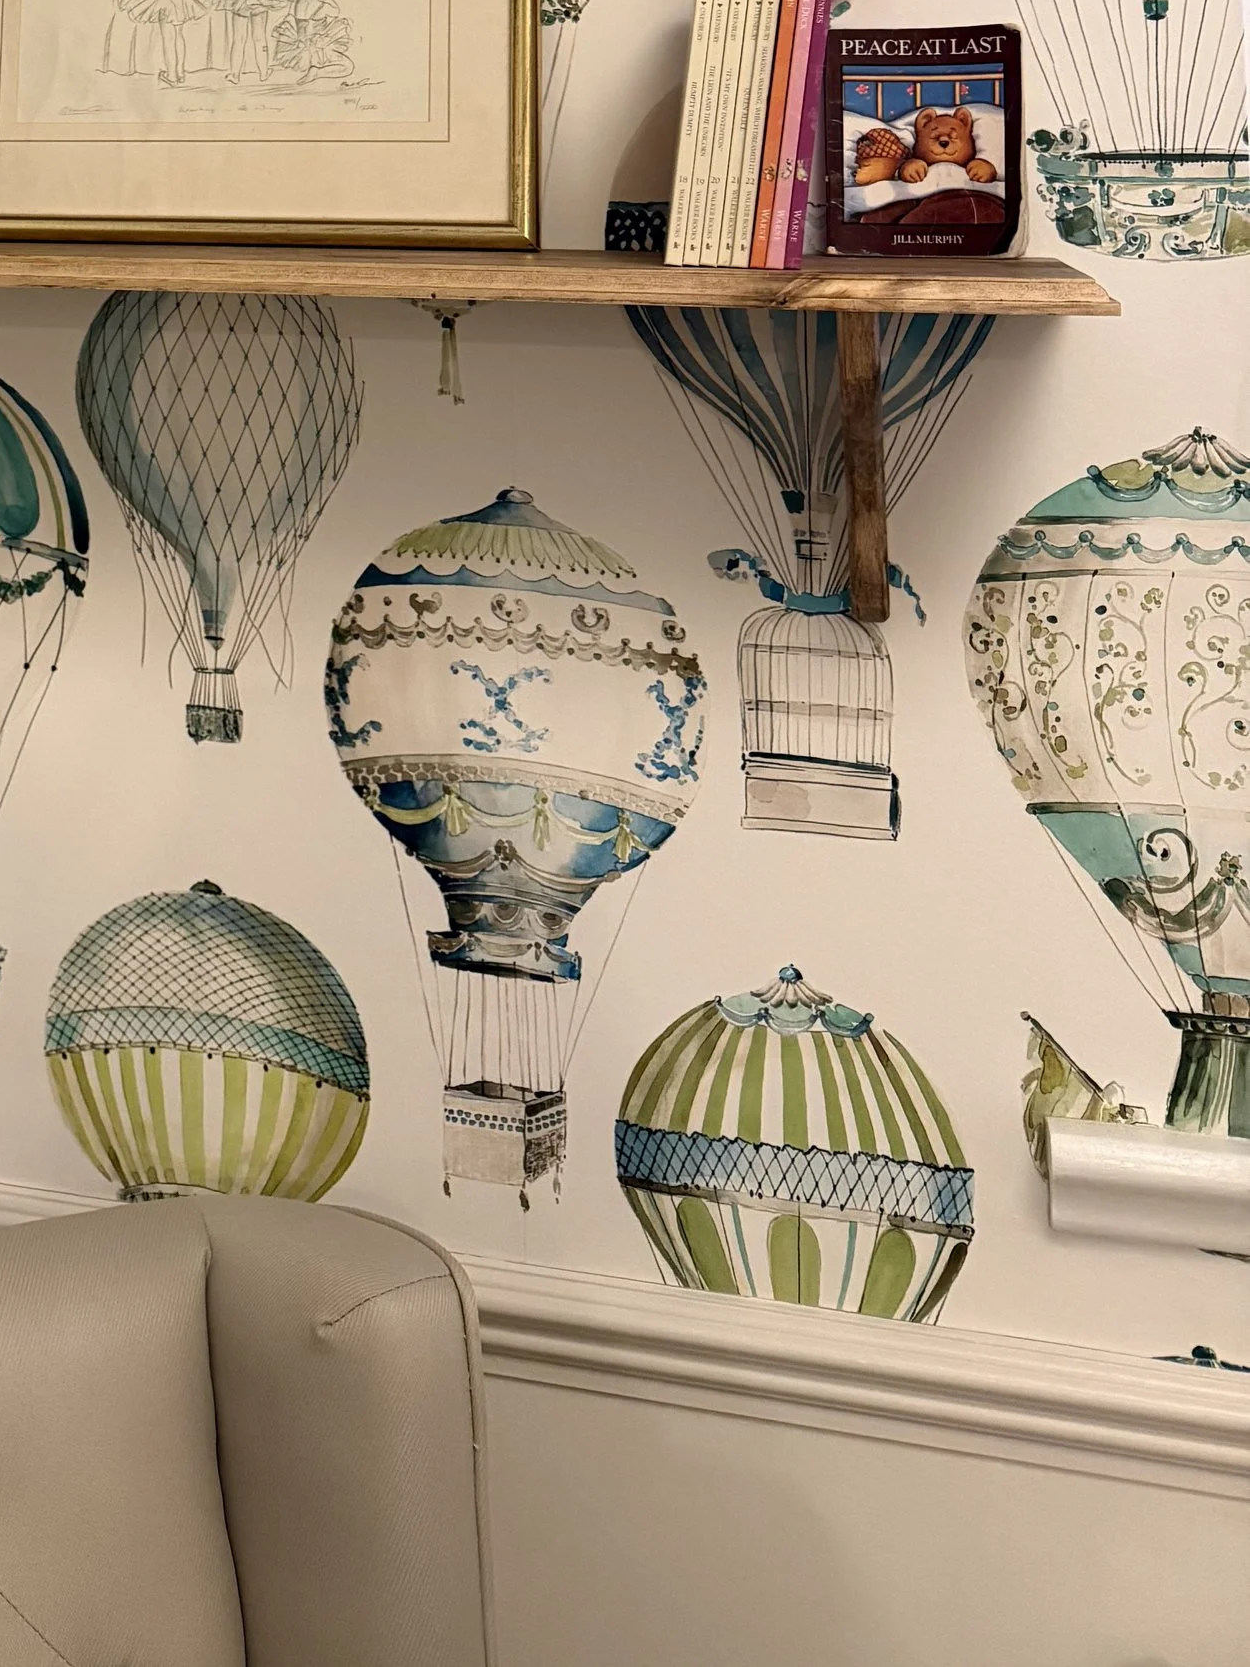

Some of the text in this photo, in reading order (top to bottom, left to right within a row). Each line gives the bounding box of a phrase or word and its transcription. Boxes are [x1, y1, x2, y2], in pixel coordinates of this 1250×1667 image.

[799, 6, 811, 30] DUCK
[840, 36, 1008, 56] PEACE AT LAST
[674, 188, 685, 238] WALKER BOOKS
[690, 190, 702, 241] WALKER BOOKS
[706, 189, 718, 240] WALKER BOOKS
[740, 190, 752, 241] WALKER BOOKS
[757, 209, 771, 241] WARNE
[773, 209, 786, 241] WARNE
[790, 210, 803, 243] WARNE
[890, 234, 966, 246] JILL MURPHY
